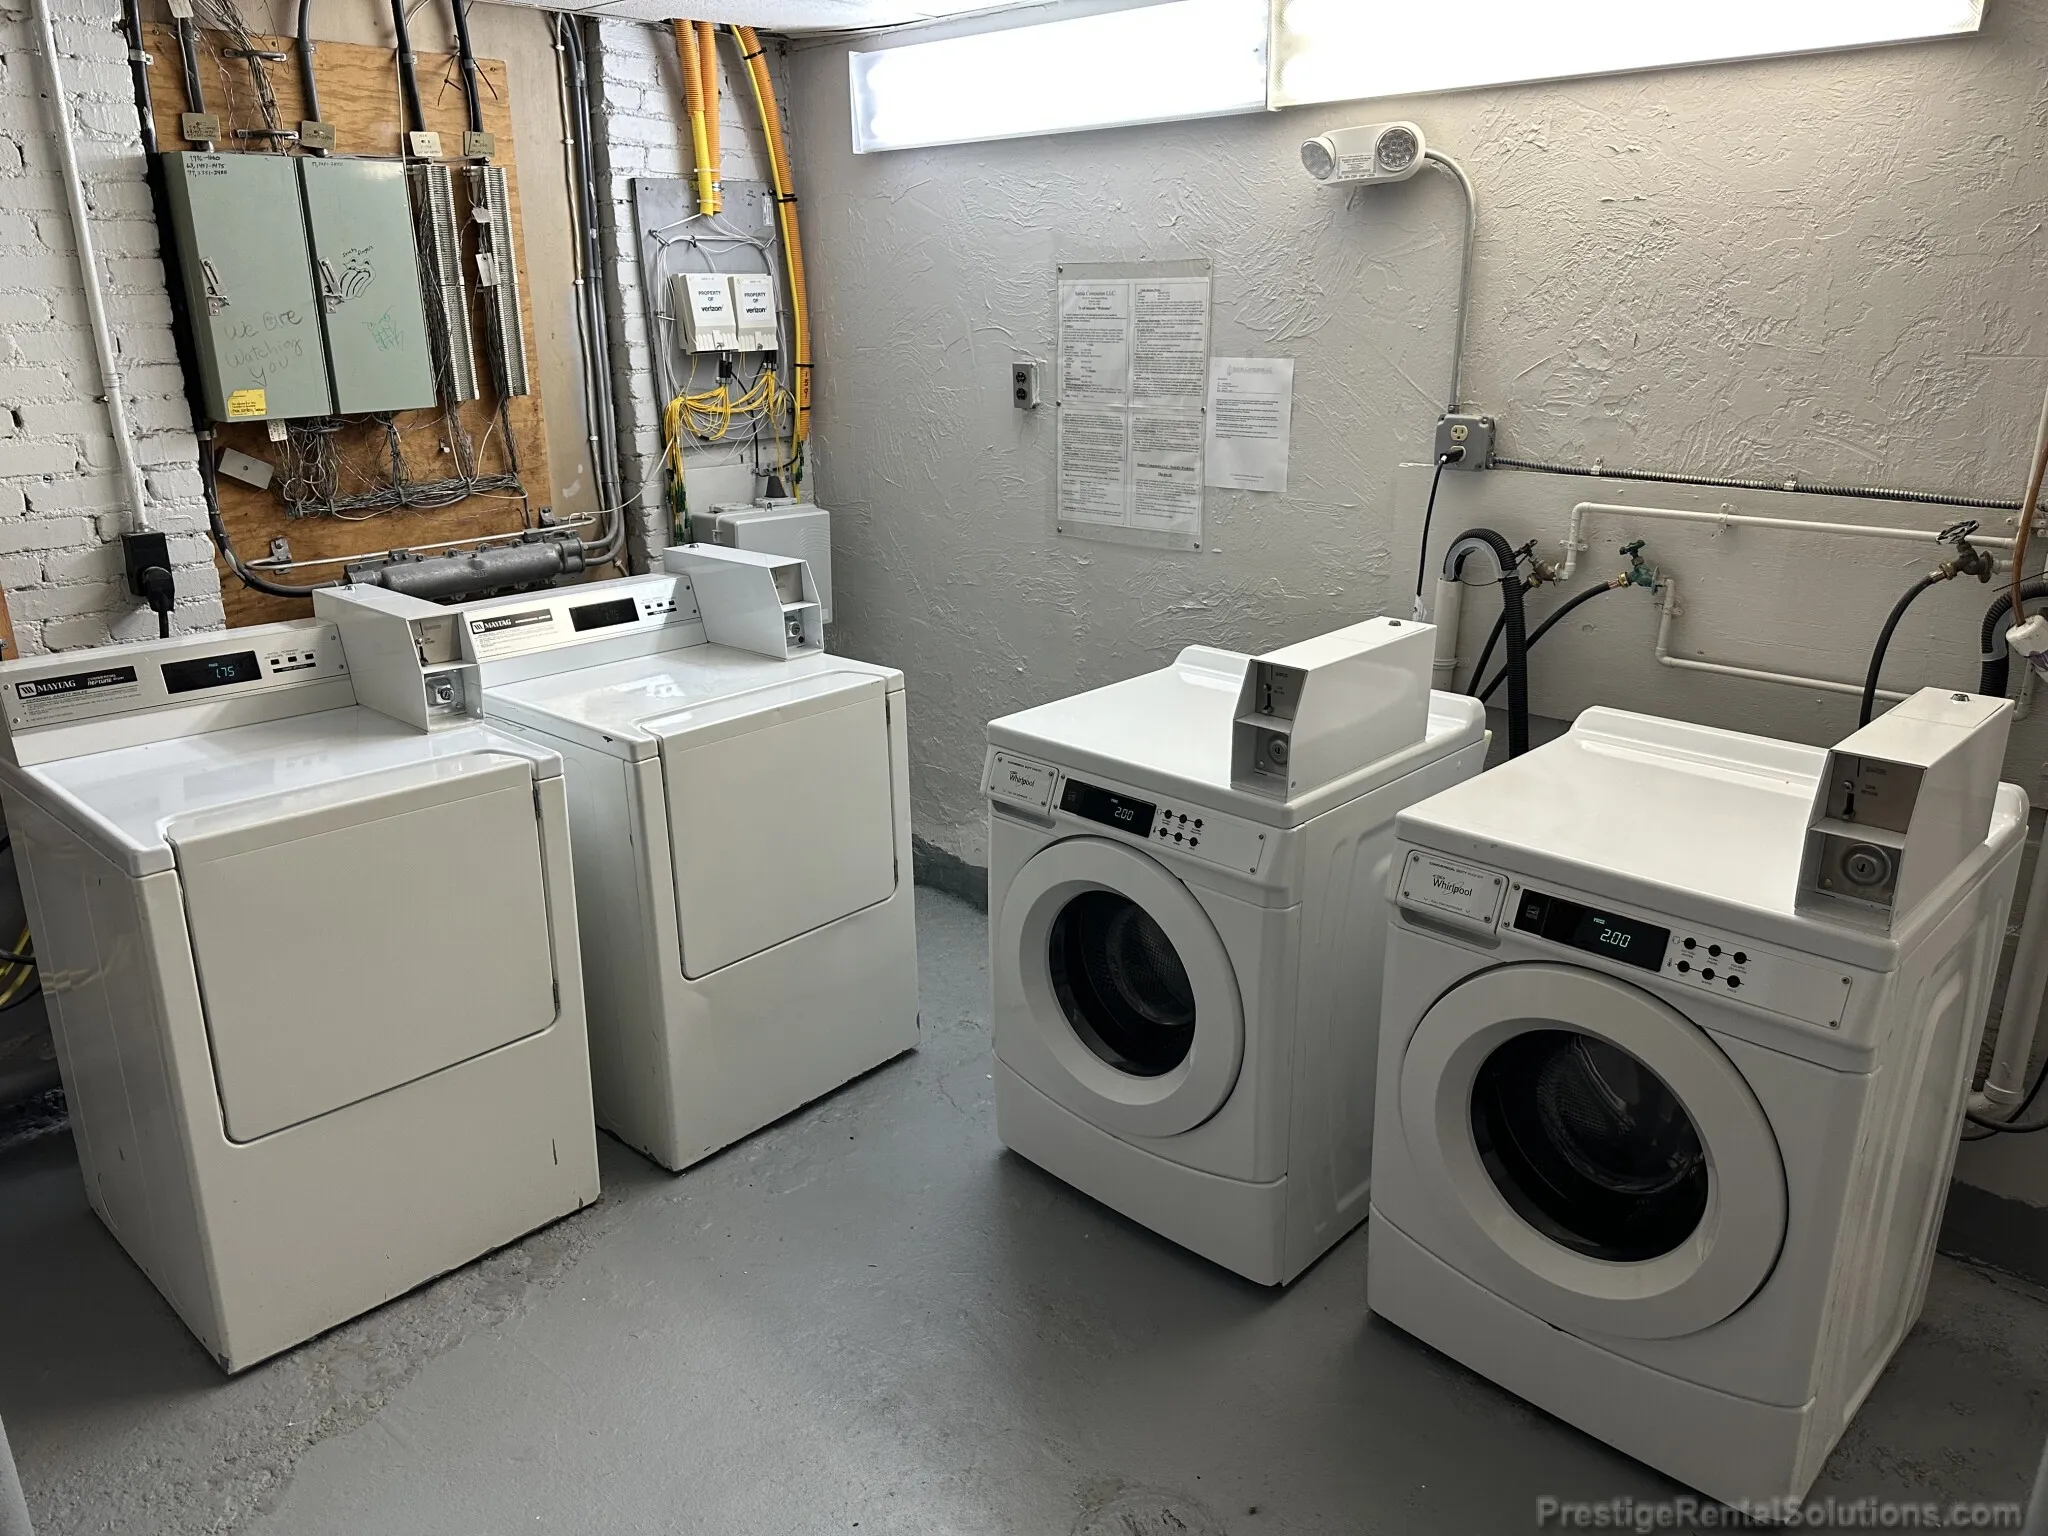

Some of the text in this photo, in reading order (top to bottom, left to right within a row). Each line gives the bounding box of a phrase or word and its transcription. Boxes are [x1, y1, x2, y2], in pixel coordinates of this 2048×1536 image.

[701, 305, 723, 313] verizon
[746, 306, 767, 314] verizon
[484, 619, 512, 629] MAYTAG
[36, 680, 76, 693] MAYTAG
[1010, 774, 1035, 787] Whirlpool
[1114, 806, 1134, 821] 2.00
[1433, 878, 1473, 897] Whirlpool
[1599, 928, 1631, 948] 2.00
